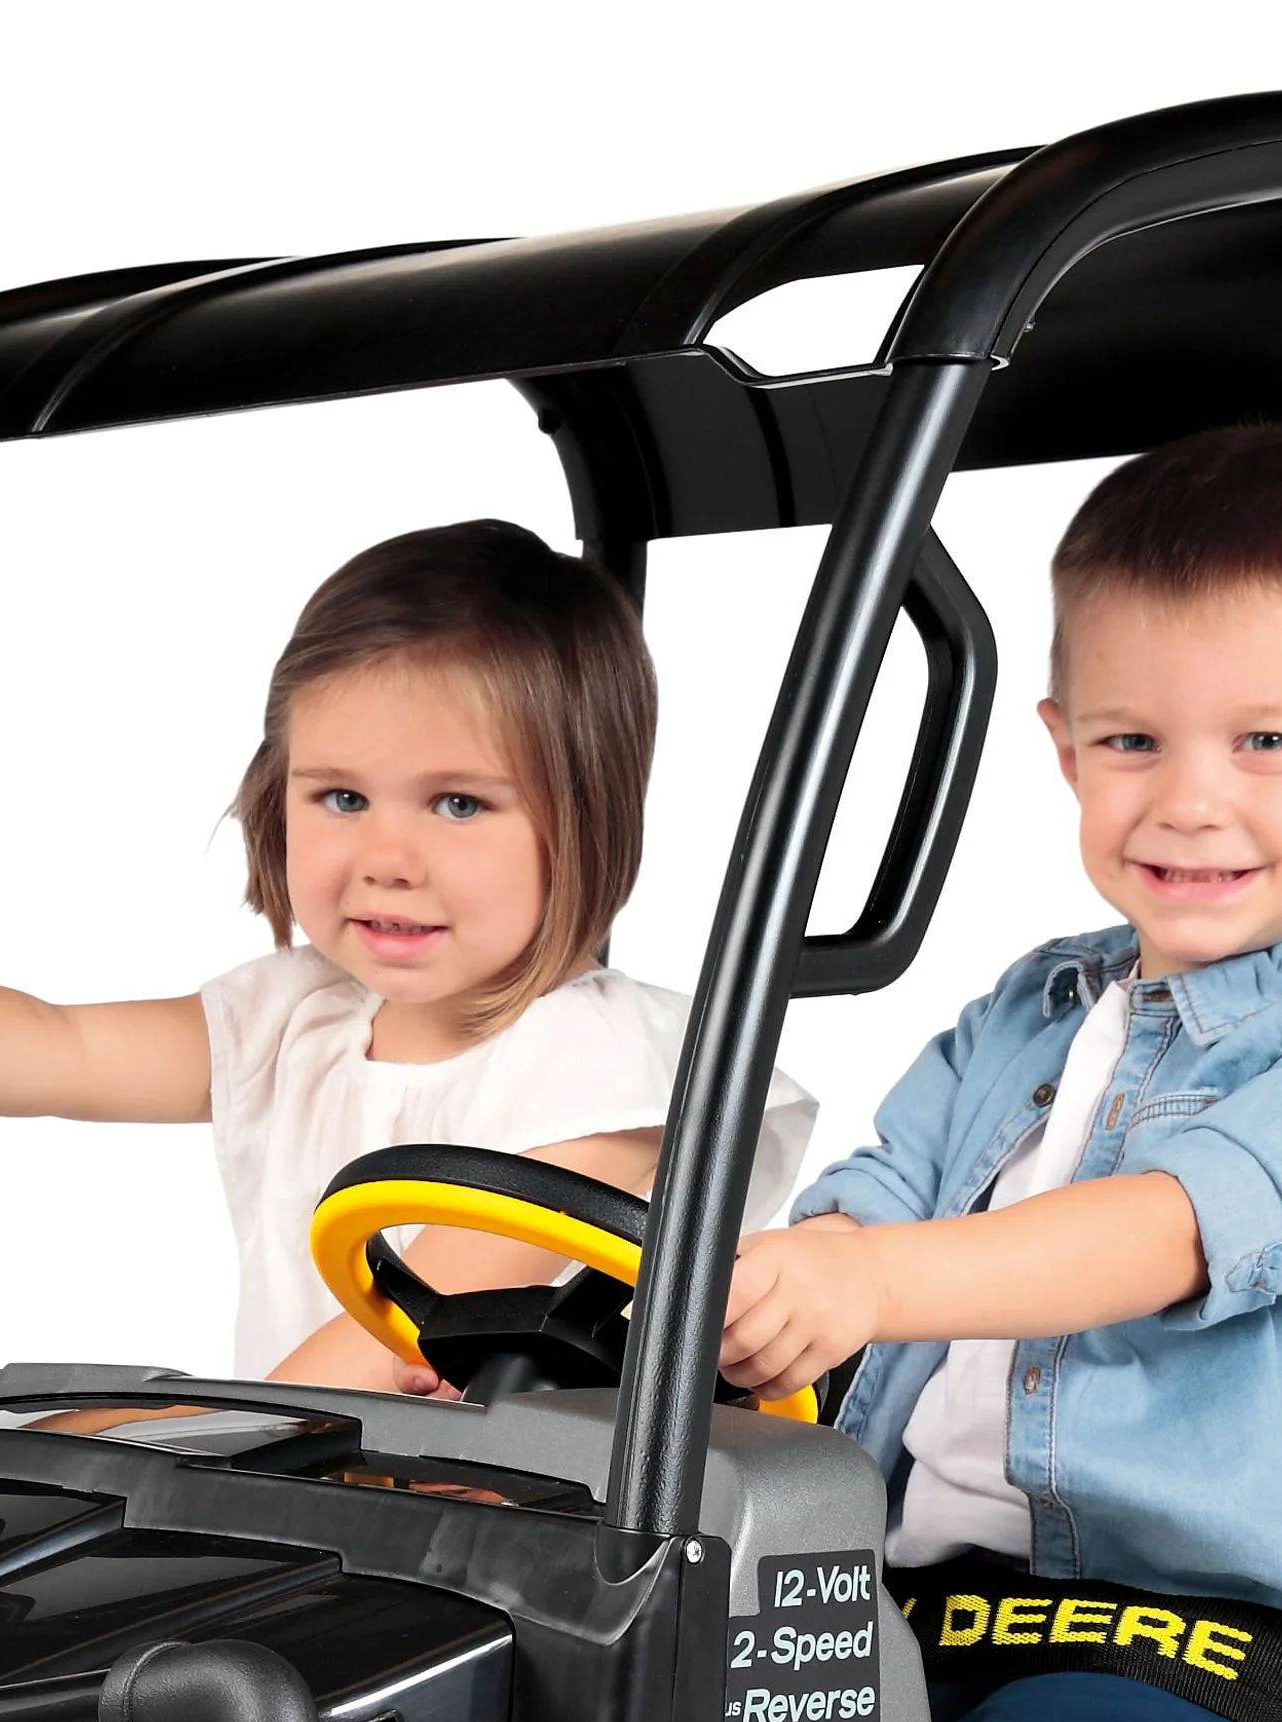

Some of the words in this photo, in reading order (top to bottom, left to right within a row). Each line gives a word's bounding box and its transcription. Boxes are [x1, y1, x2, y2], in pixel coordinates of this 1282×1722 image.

[774, 1565, 871, 1608] 12-Volt
[730, 1620, 874, 1671] 2-Speed
[939, 1594, 1254, 1681] DEERE
